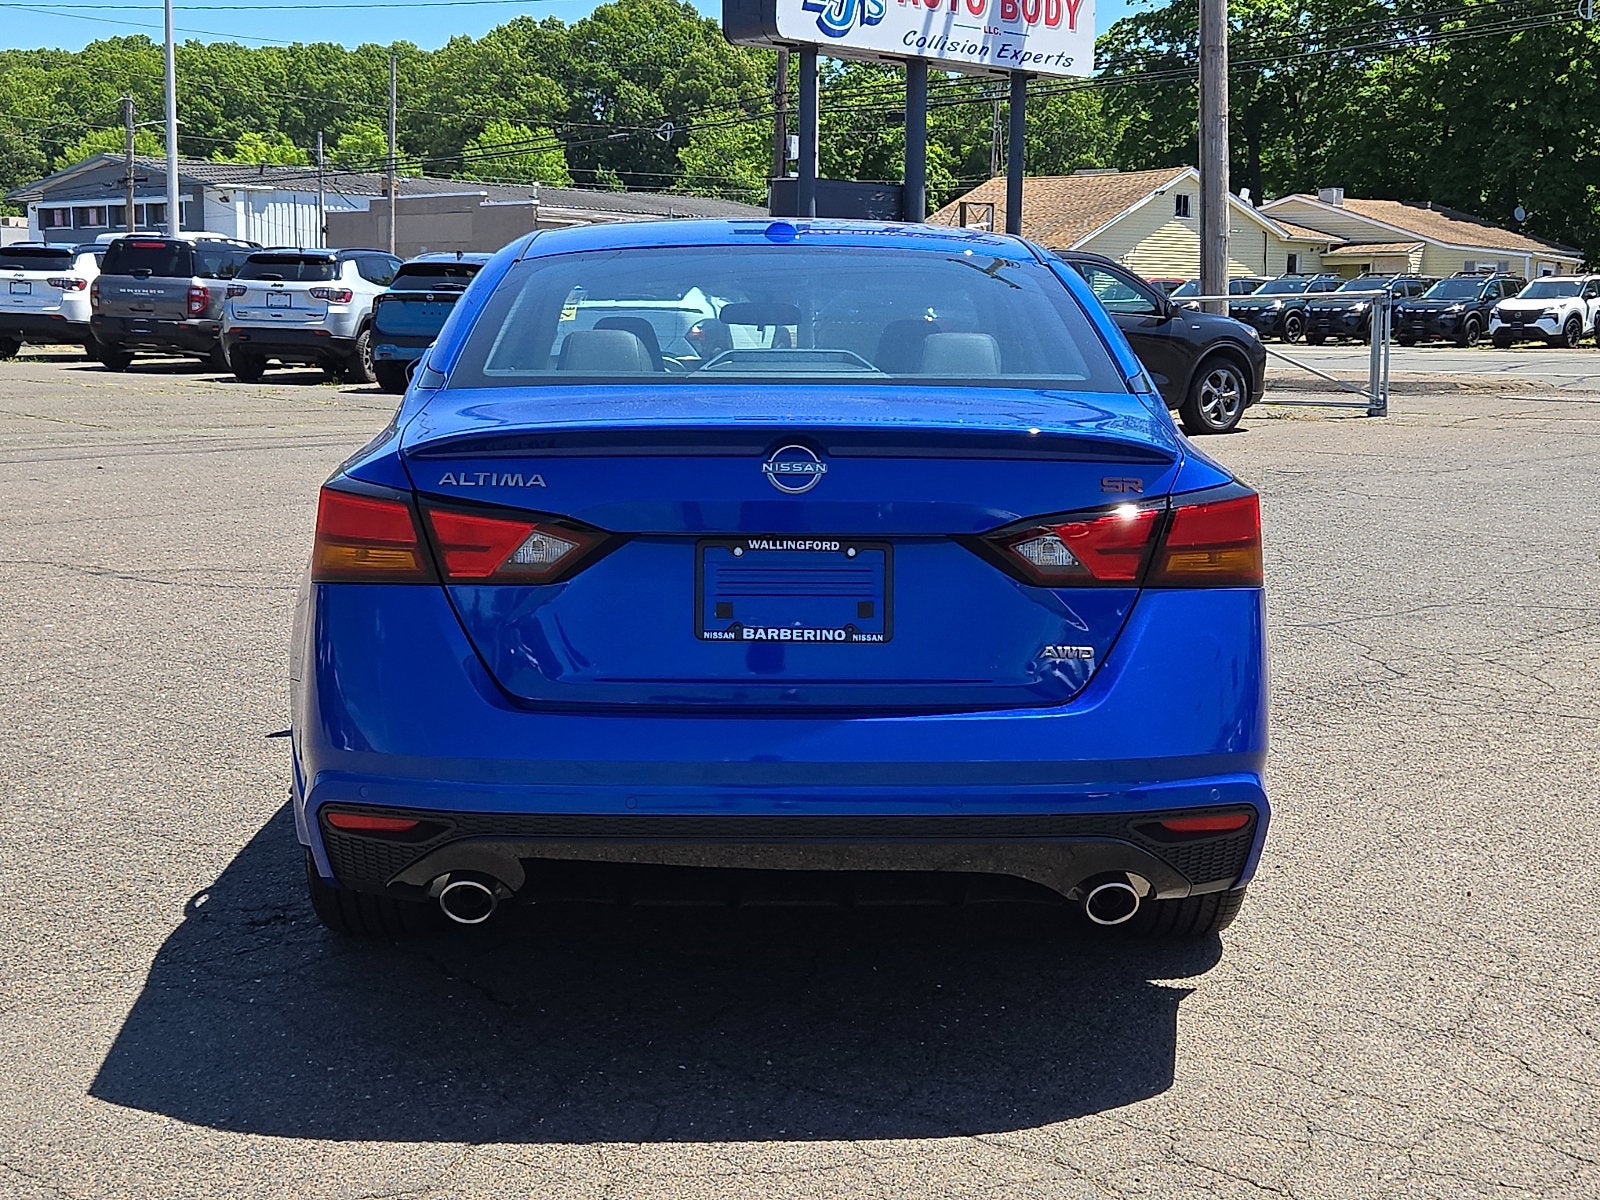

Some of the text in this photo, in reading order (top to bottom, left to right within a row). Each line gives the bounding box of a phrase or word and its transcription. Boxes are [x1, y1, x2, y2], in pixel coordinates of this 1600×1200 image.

[902, 30, 1075, 68] Collision Experts
[761, 462, 828, 474] NISSAN
[438, 472, 547, 488] ALTIMA
[1101, 477, 1144, 493] SR
[748, 539, 840, 551] WALLINGFORD
[703, 628, 884, 642] NISSAN BARBERINO NISSAN
[1040, 645, 1095, 660] AWD
